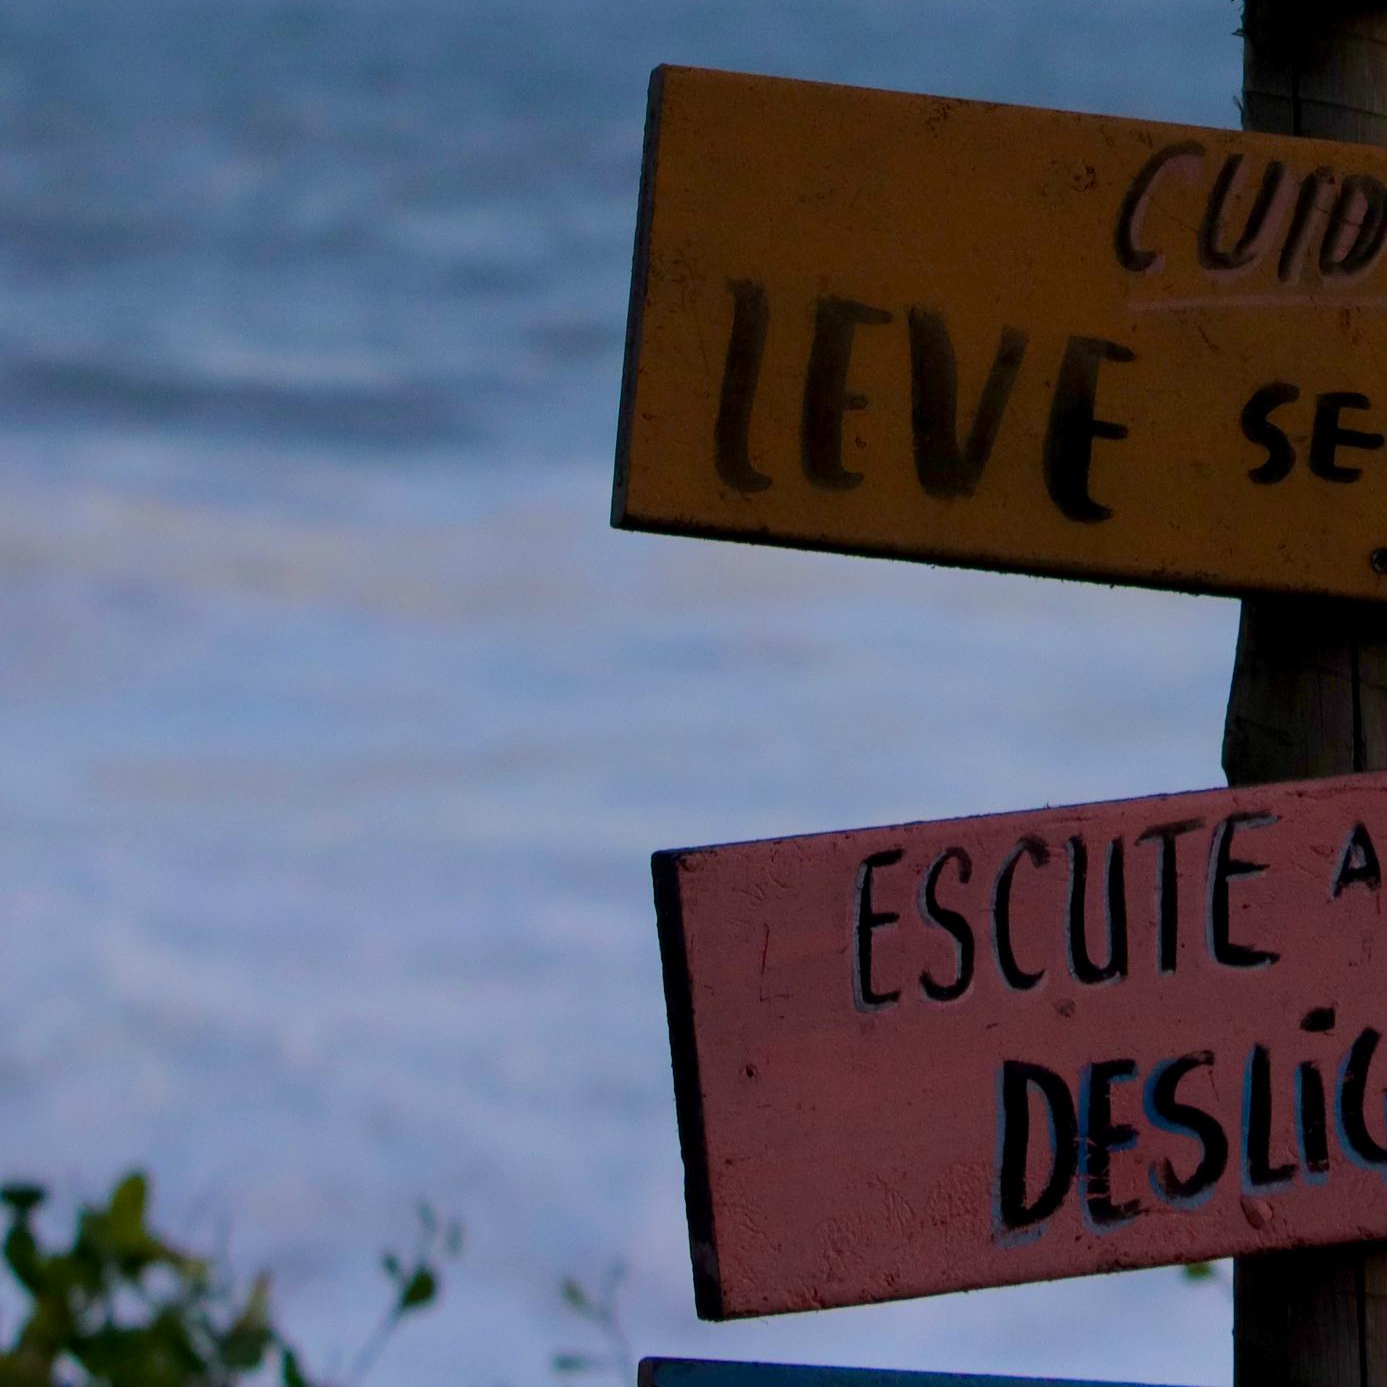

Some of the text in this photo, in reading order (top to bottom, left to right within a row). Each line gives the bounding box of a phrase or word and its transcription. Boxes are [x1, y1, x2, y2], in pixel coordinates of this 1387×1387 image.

[713, 278, 1137, 524] LEVE
[852, 810, 1283, 1013] ESCUTE
[1329, 821, 1384, 902] A
